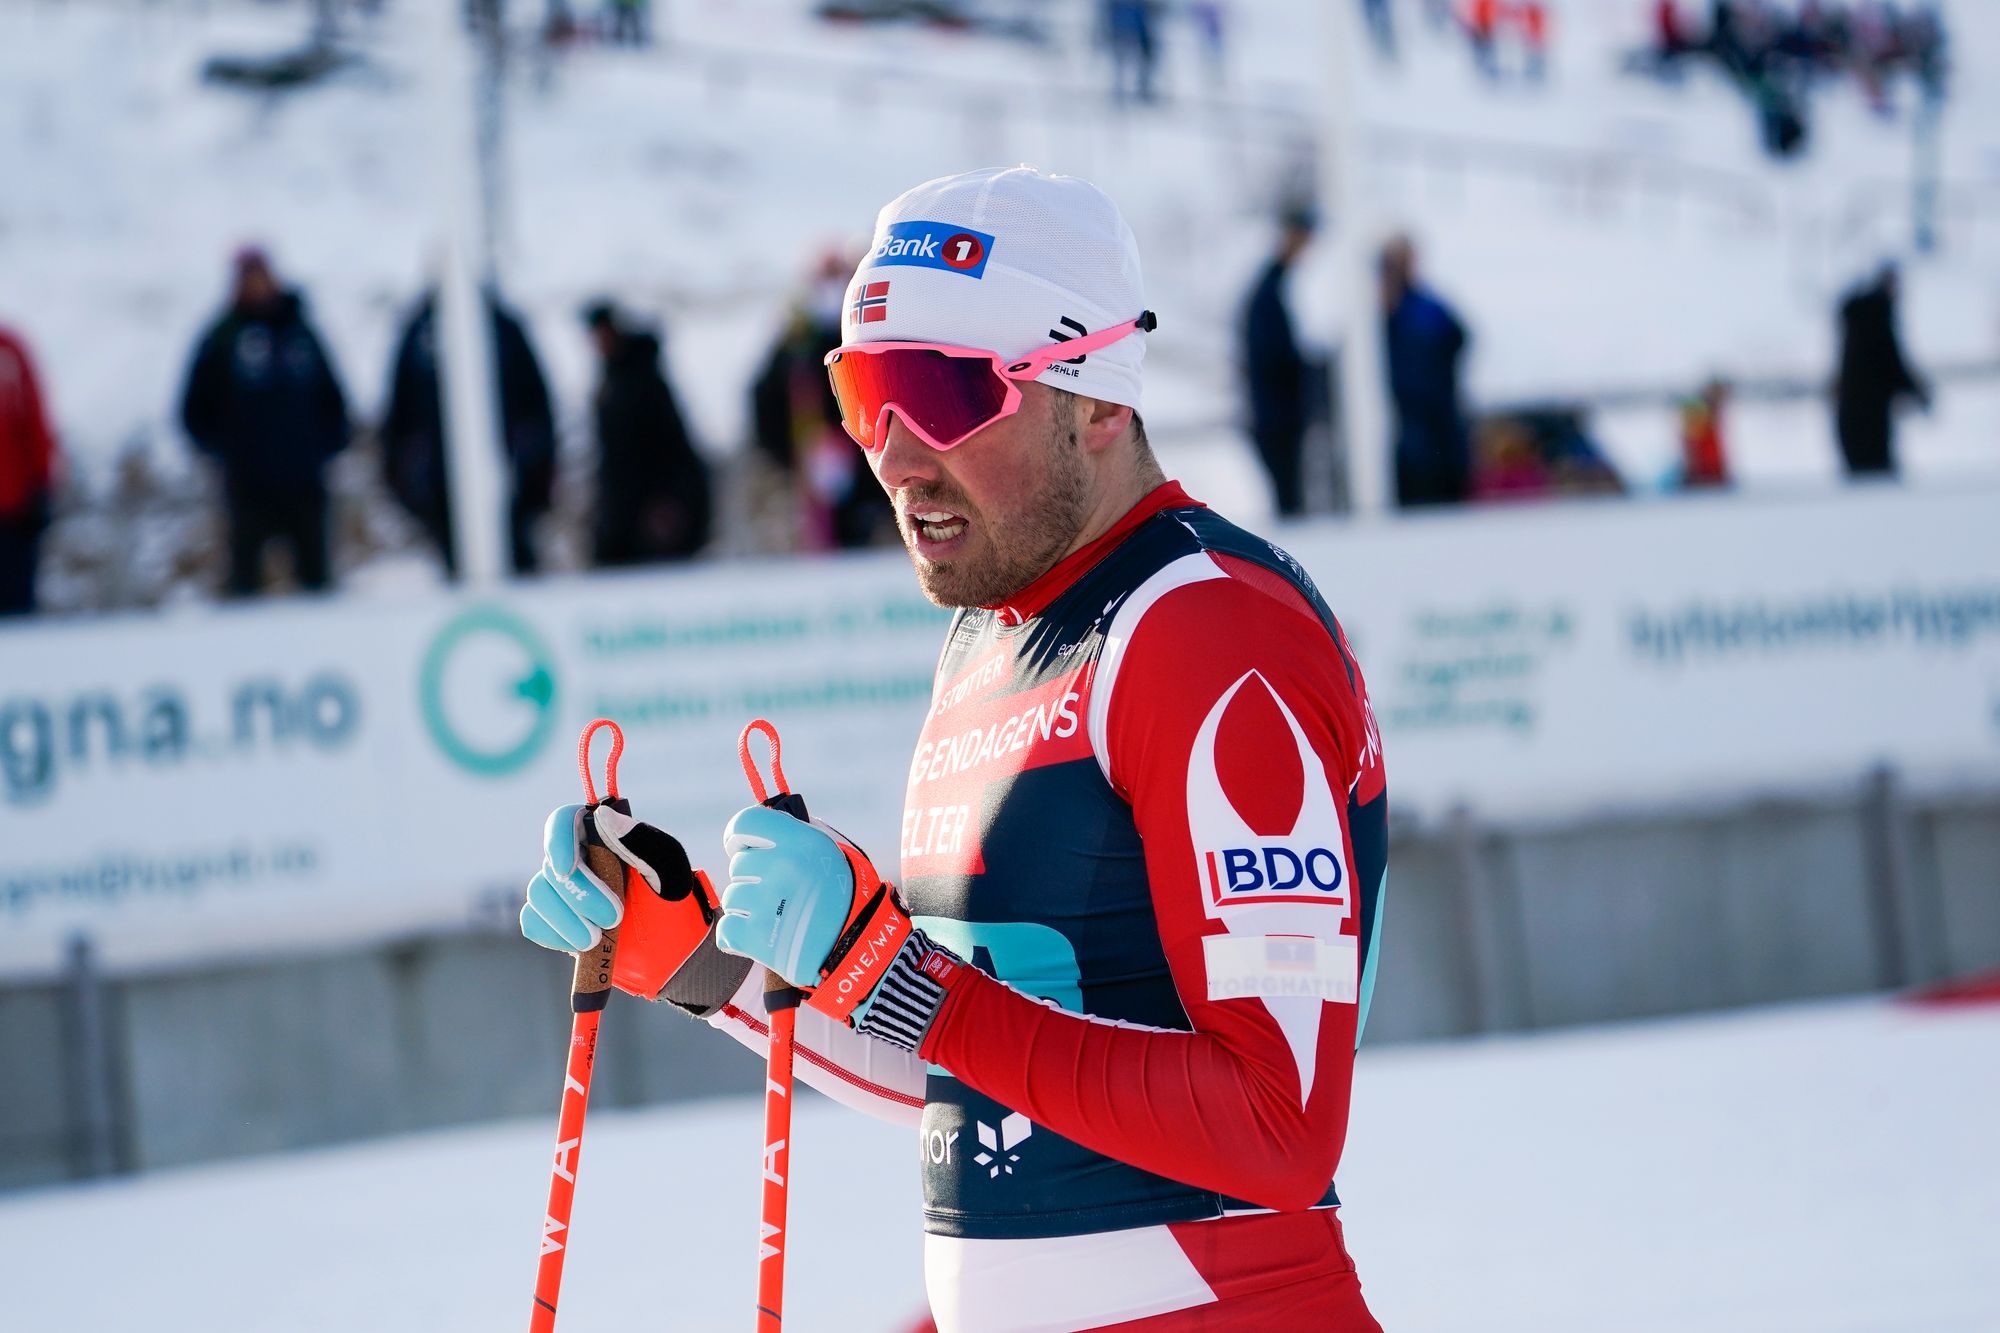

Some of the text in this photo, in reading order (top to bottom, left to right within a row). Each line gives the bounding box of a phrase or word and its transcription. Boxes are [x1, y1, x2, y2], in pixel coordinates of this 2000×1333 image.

[876, 233, 973, 262] Bank 1
[0, 671, 360, 796] gna.no
[910, 691, 1080, 787] GENDAGENS
[901, 804, 970, 860] ELTER
[1222, 847, 1342, 893] BDO
[776, 898, 787, 917] Slim
[598, 930, 616, 984] ONE/
[838, 911, 901, 994] ONE/WAY
[540, 1072, 585, 1258] WAY
[760, 1077, 786, 1263] WAY
[920, 1129, 959, 1165] nor
